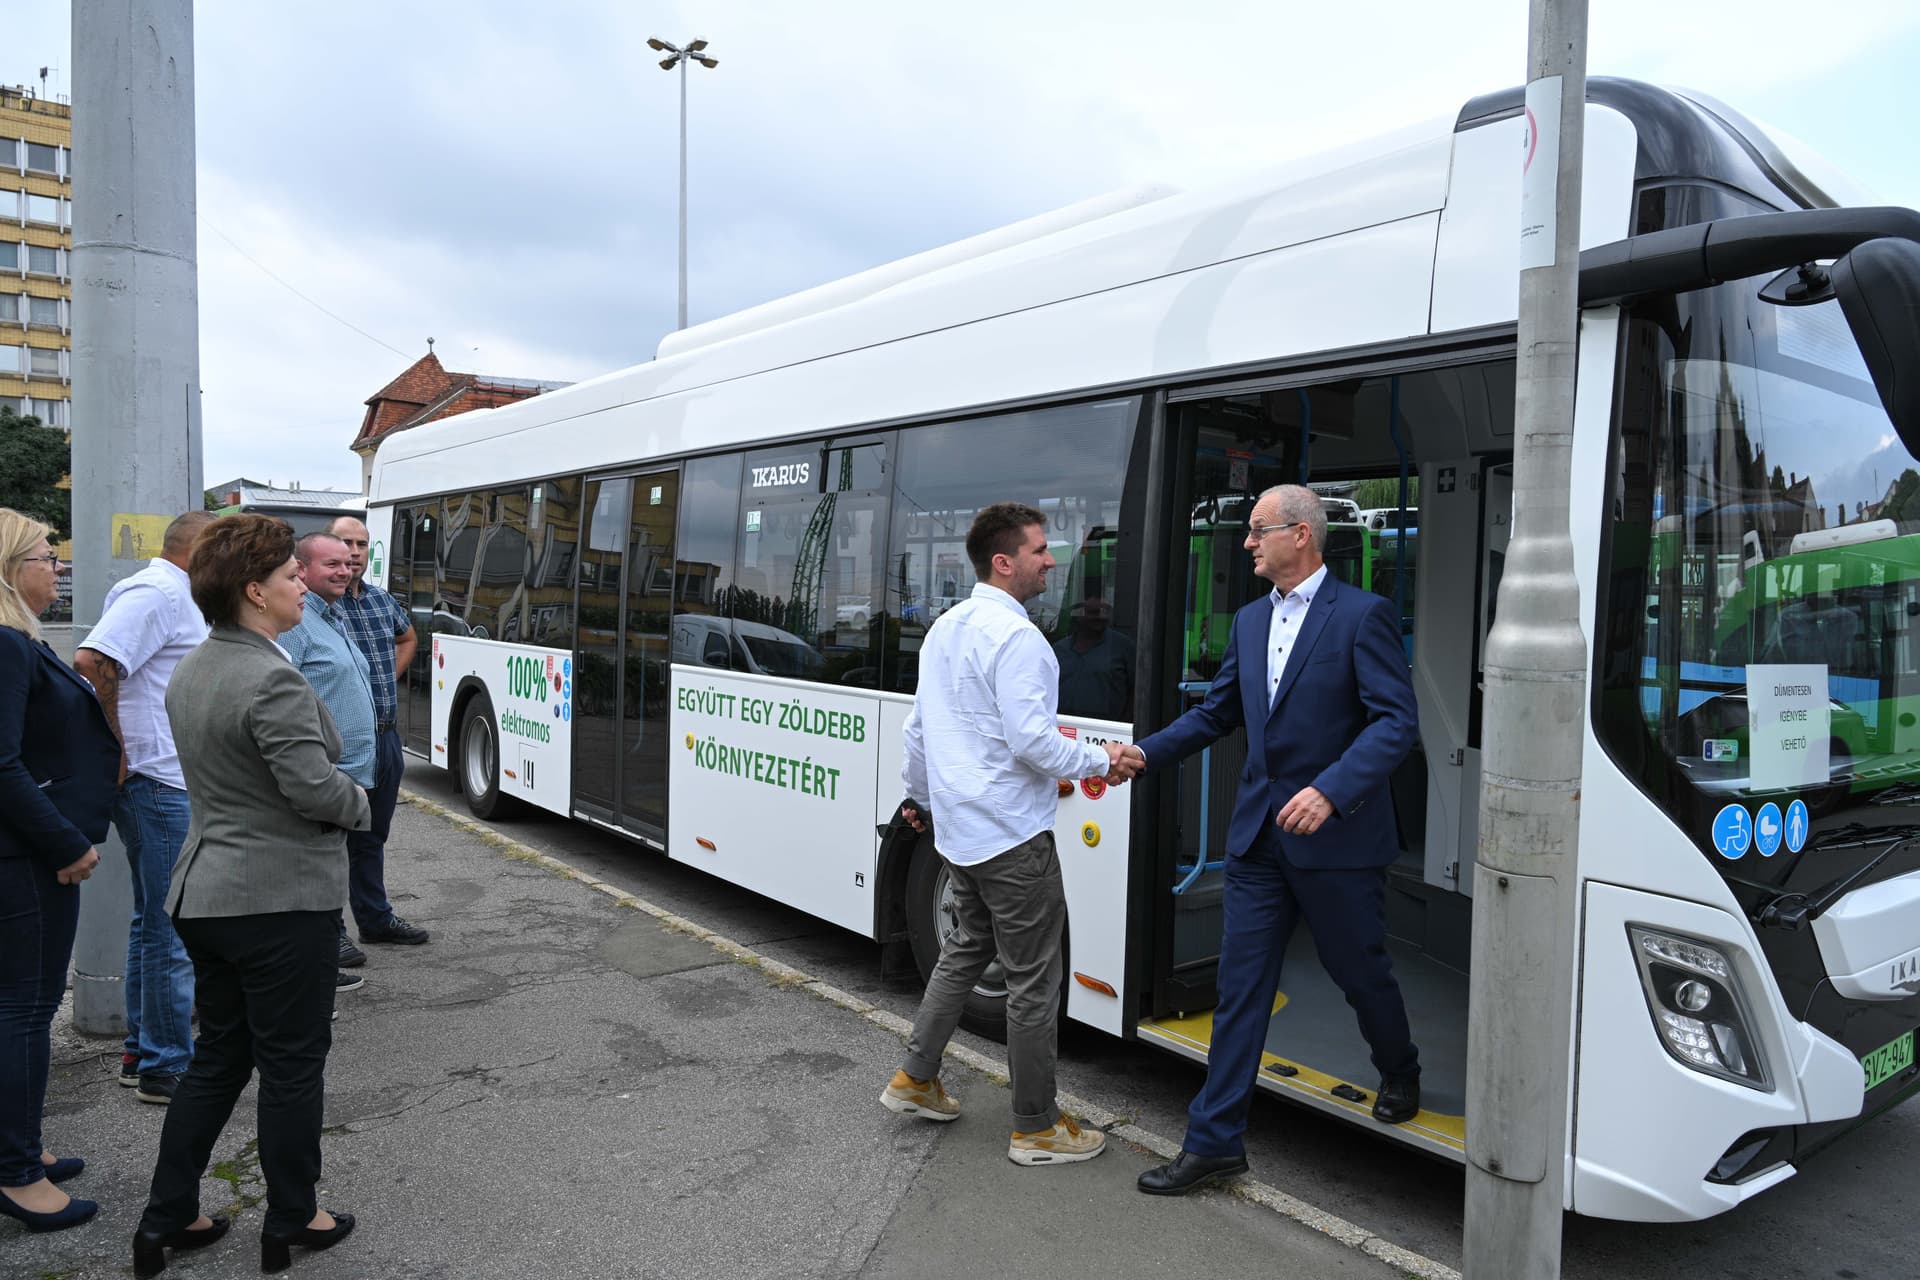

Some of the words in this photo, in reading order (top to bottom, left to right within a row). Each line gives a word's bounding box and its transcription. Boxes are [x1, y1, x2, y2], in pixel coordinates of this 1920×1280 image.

[751, 462, 810, 488] IKARUS
[506, 655, 547, 703] 100%
[501, 707, 551, 744] elektromos
[677, 686, 737, 719] EGYÜTT
[741, 697, 774, 726] EGY
[778, 699, 866, 743] ZÖLDEBB
[695, 736, 841, 801] KÖRNYEZETÉRT
[1891, 955, 1920, 985] IKA
[1864, 1033, 1912, 1089] SVZ-947
